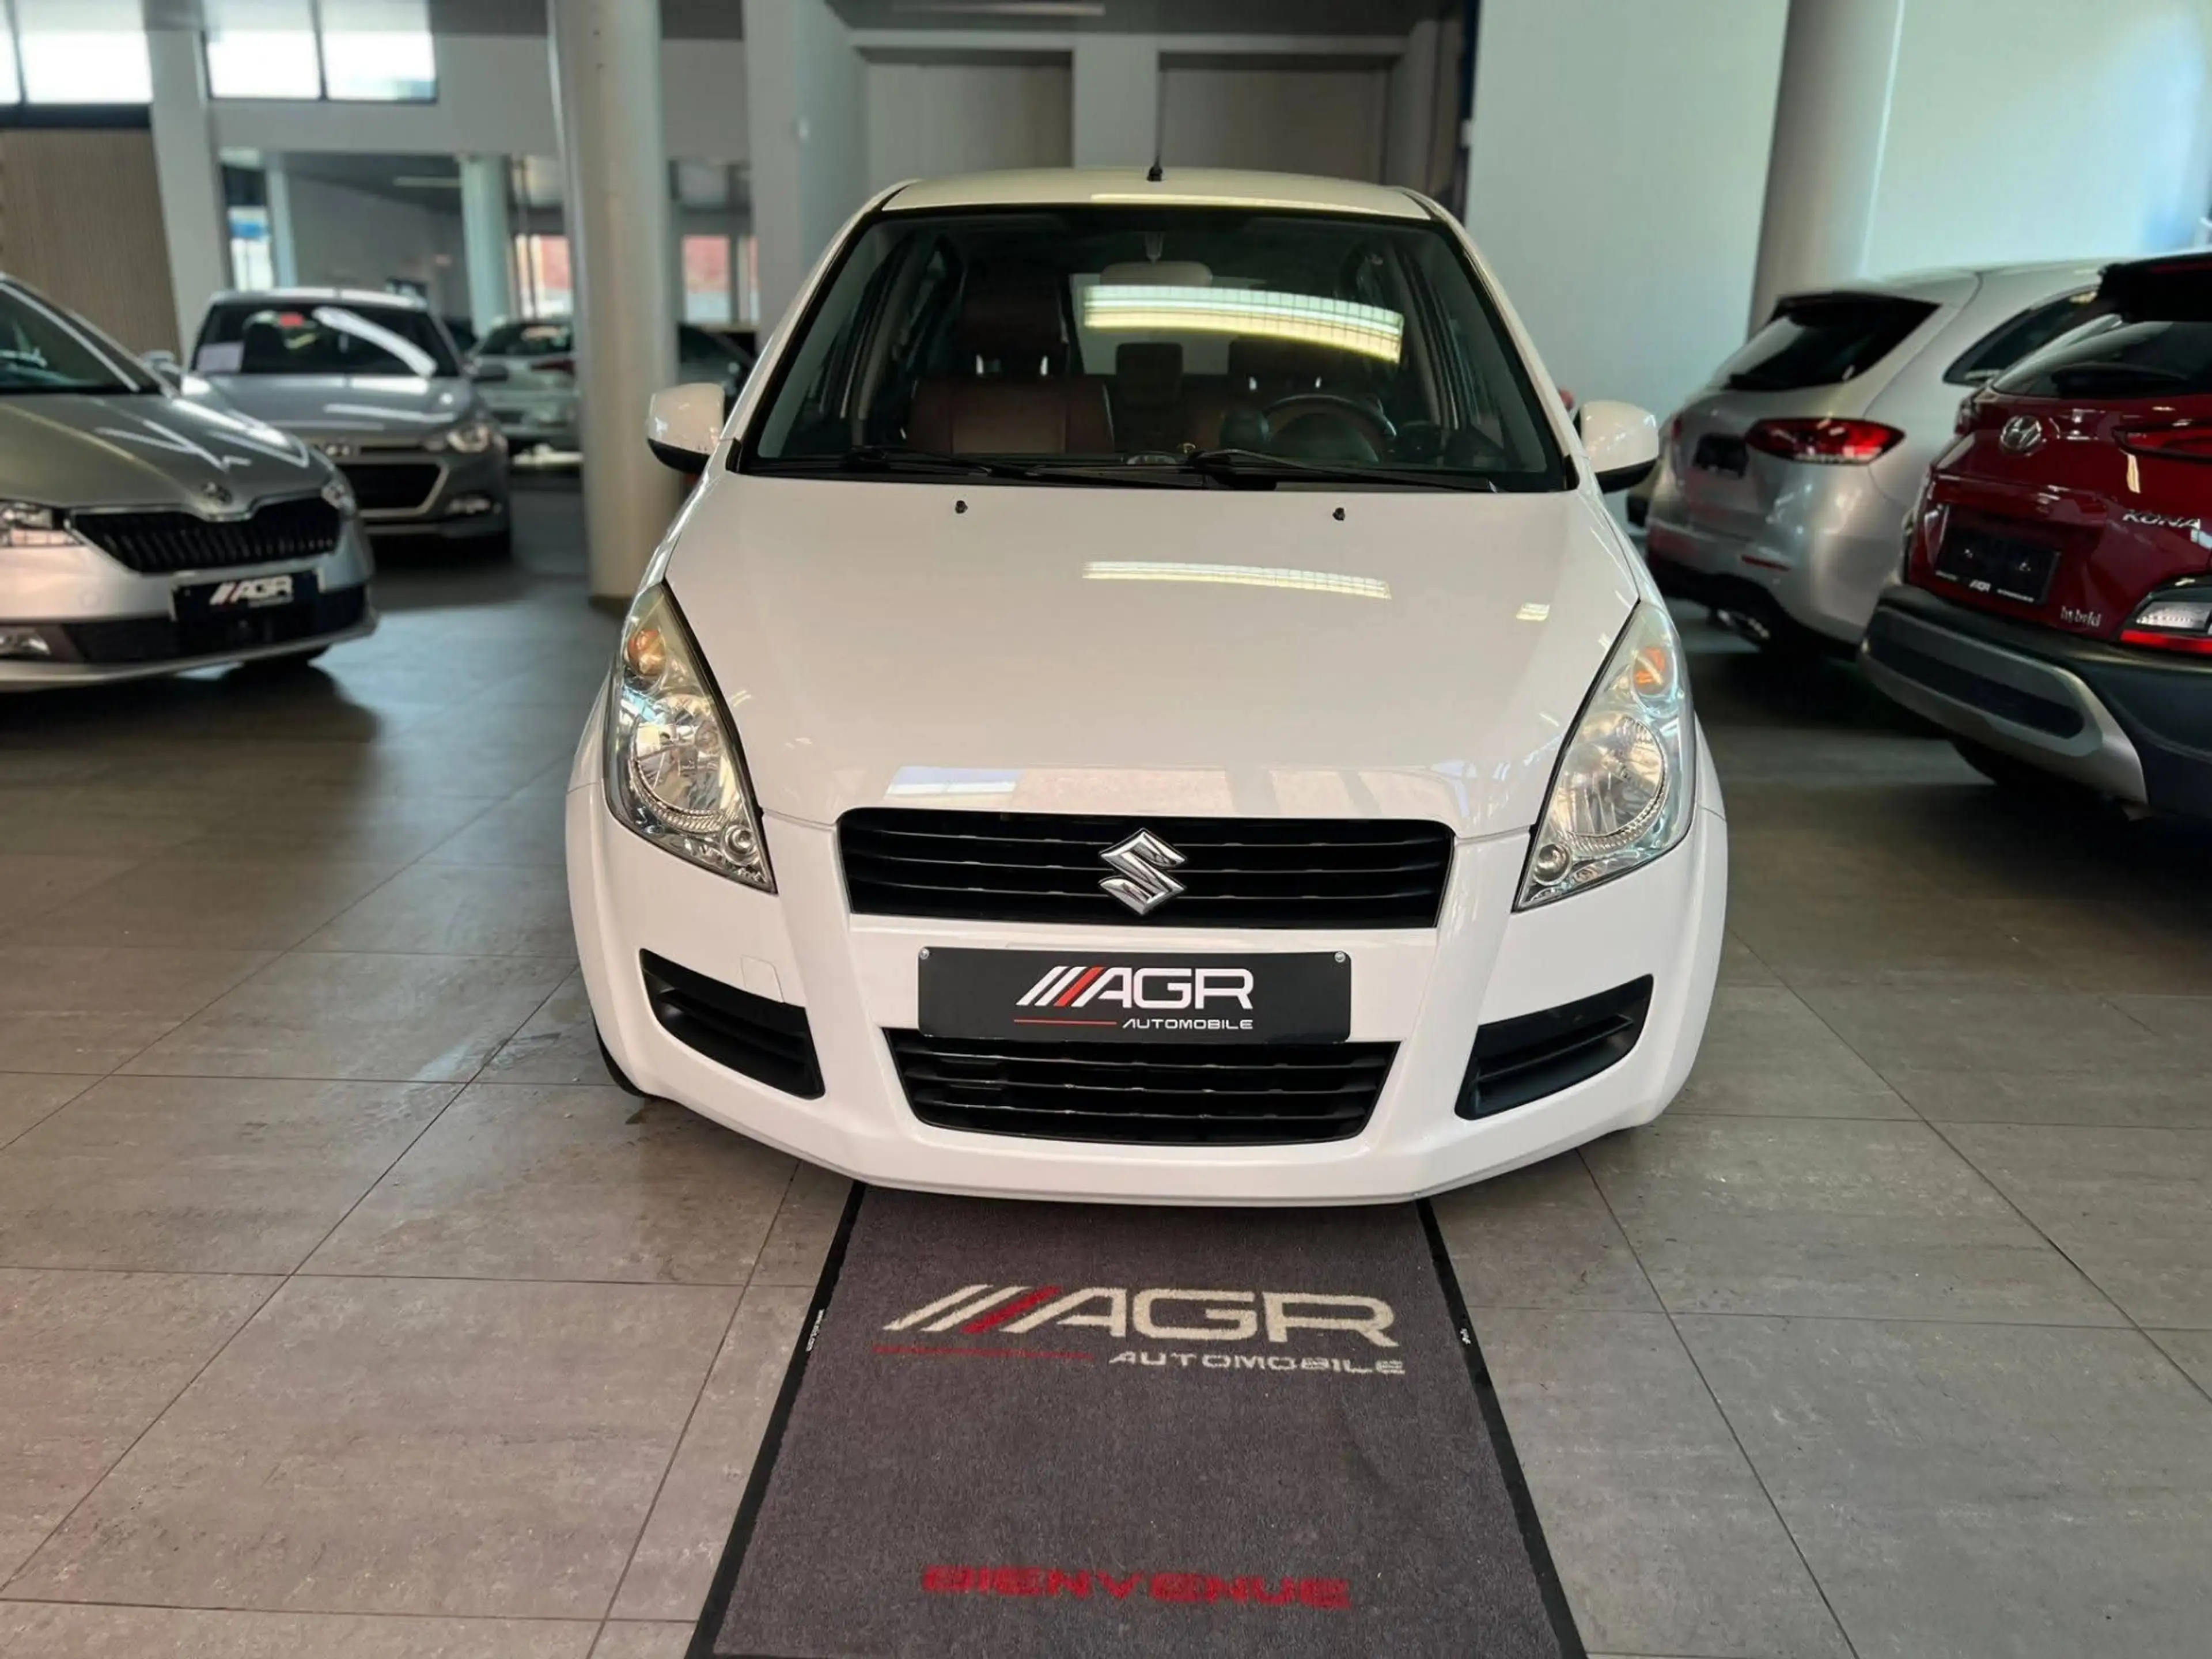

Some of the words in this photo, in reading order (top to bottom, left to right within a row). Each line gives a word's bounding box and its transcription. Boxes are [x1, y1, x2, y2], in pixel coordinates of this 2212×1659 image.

[2122, 509, 2201, 529] KONA
[1071, 967, 1254, 1010] AGR
[1122, 1018, 1254, 1030] AUTOMOBILE
[999, 1287, 1399, 1348] AGR
[1108, 1350, 1406, 1375] AUTOMOBILE
[922, 1565, 1351, 1609] BIENVENUE
